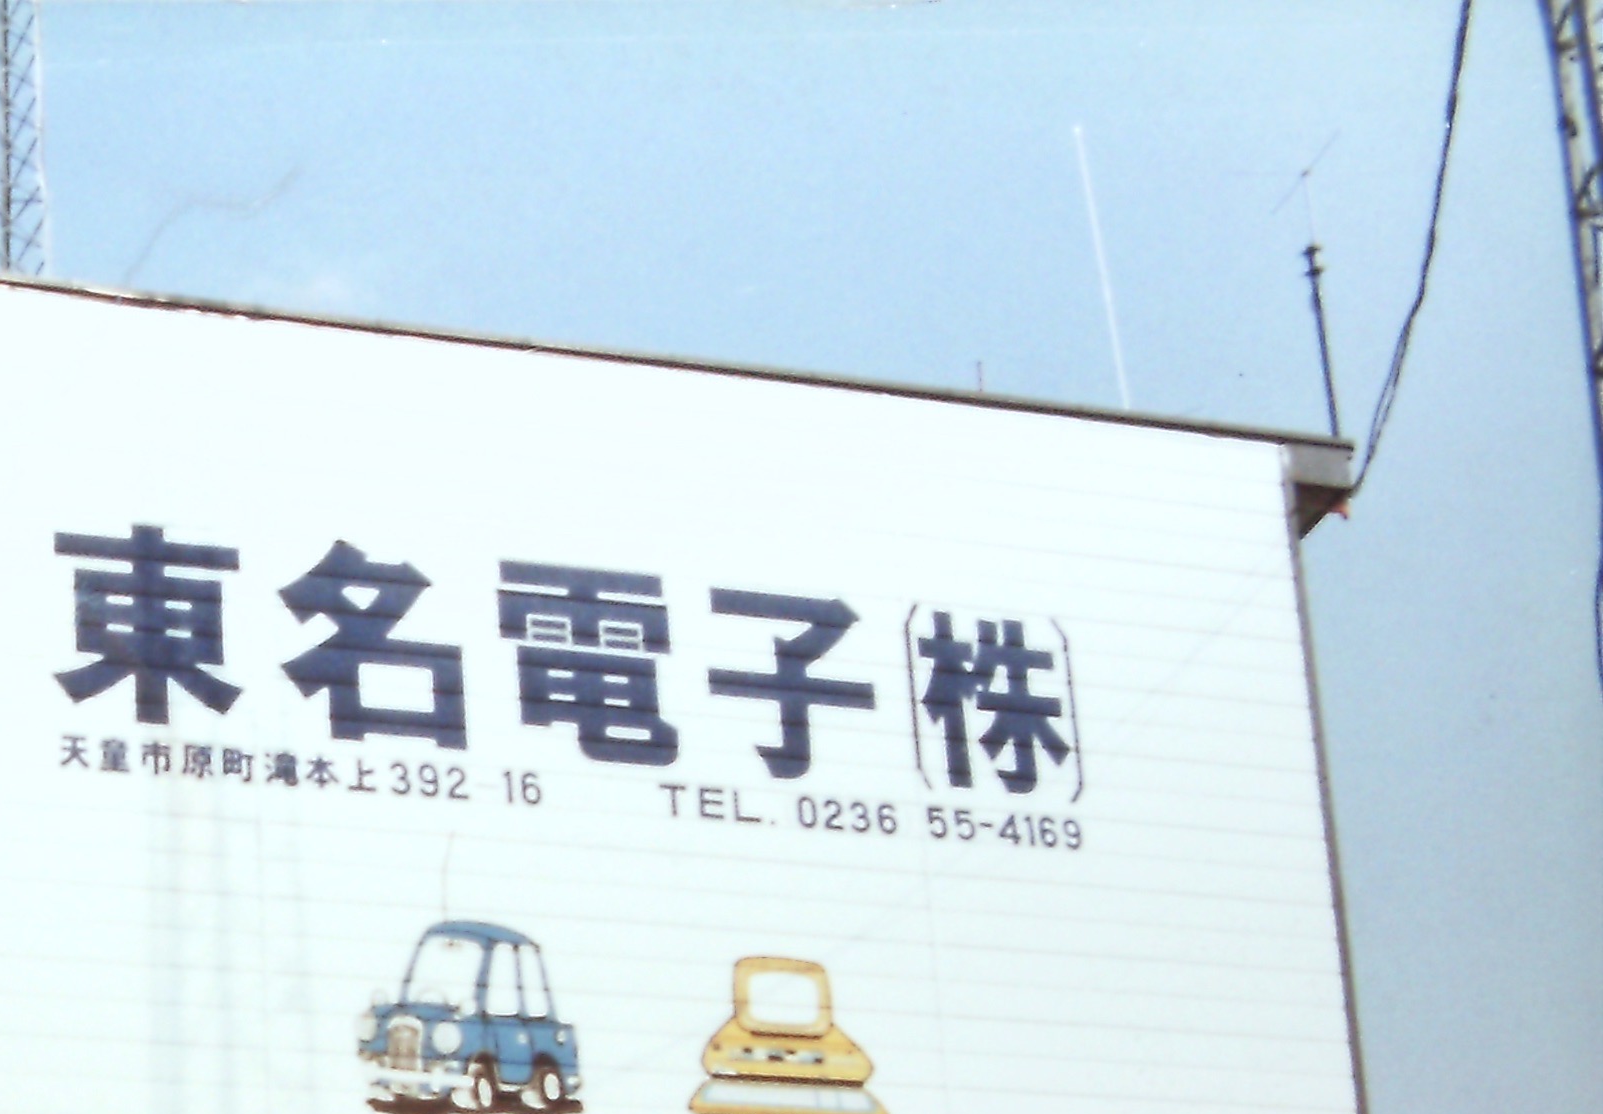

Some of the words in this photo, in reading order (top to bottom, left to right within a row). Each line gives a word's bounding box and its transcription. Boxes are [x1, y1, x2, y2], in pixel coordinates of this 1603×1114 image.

[658, 783, 775, 826] TEL.
[796, 795, 898, 836] 0236
[926, 804, 1083, 852] 55-4169
